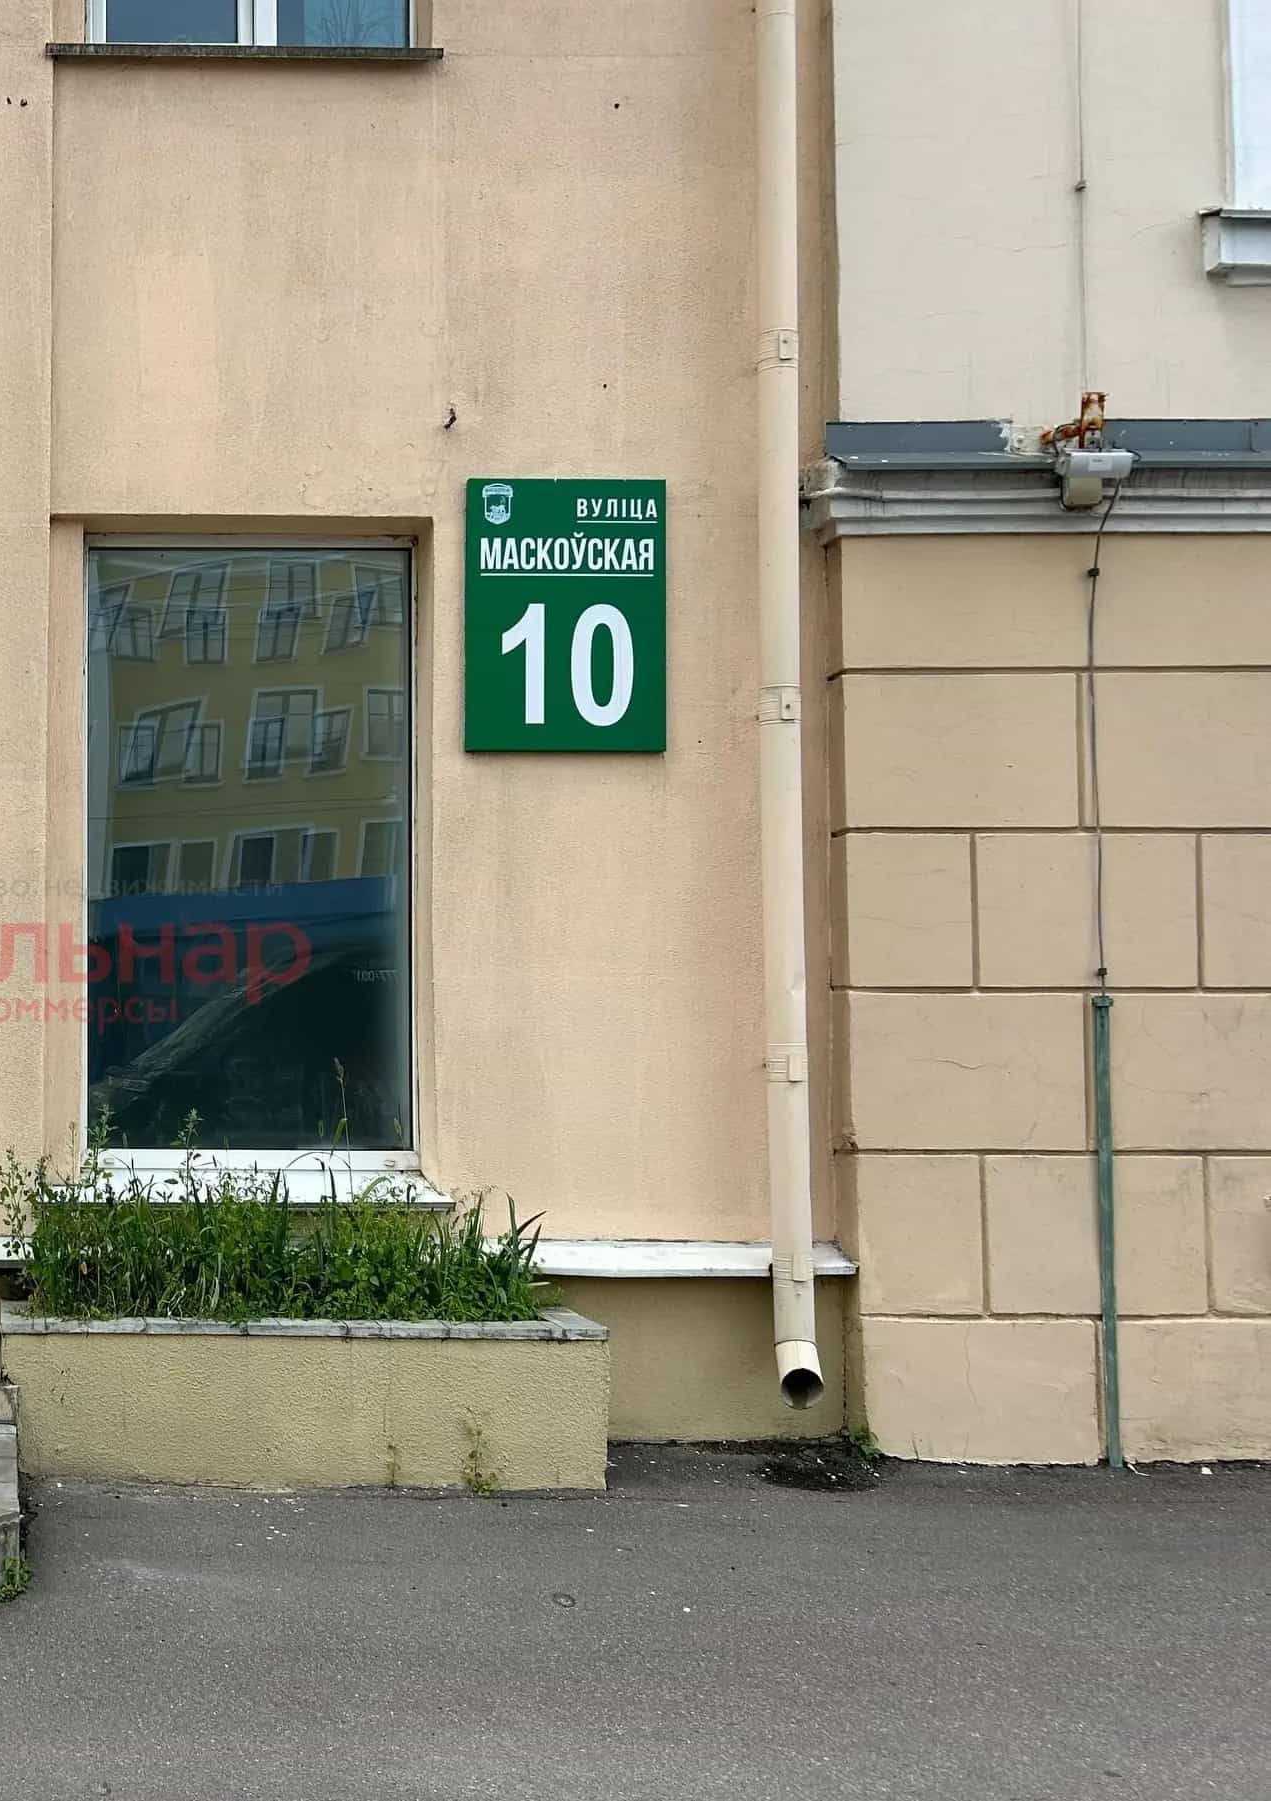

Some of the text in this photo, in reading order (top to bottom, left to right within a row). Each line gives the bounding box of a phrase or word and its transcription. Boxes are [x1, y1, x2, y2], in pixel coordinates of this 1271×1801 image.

[577, 498, 658, 520] ВУЛІЦА
[480, 532, 655, 571] МАСКОЎСКАЯ
[501, 603, 634, 727] 10
